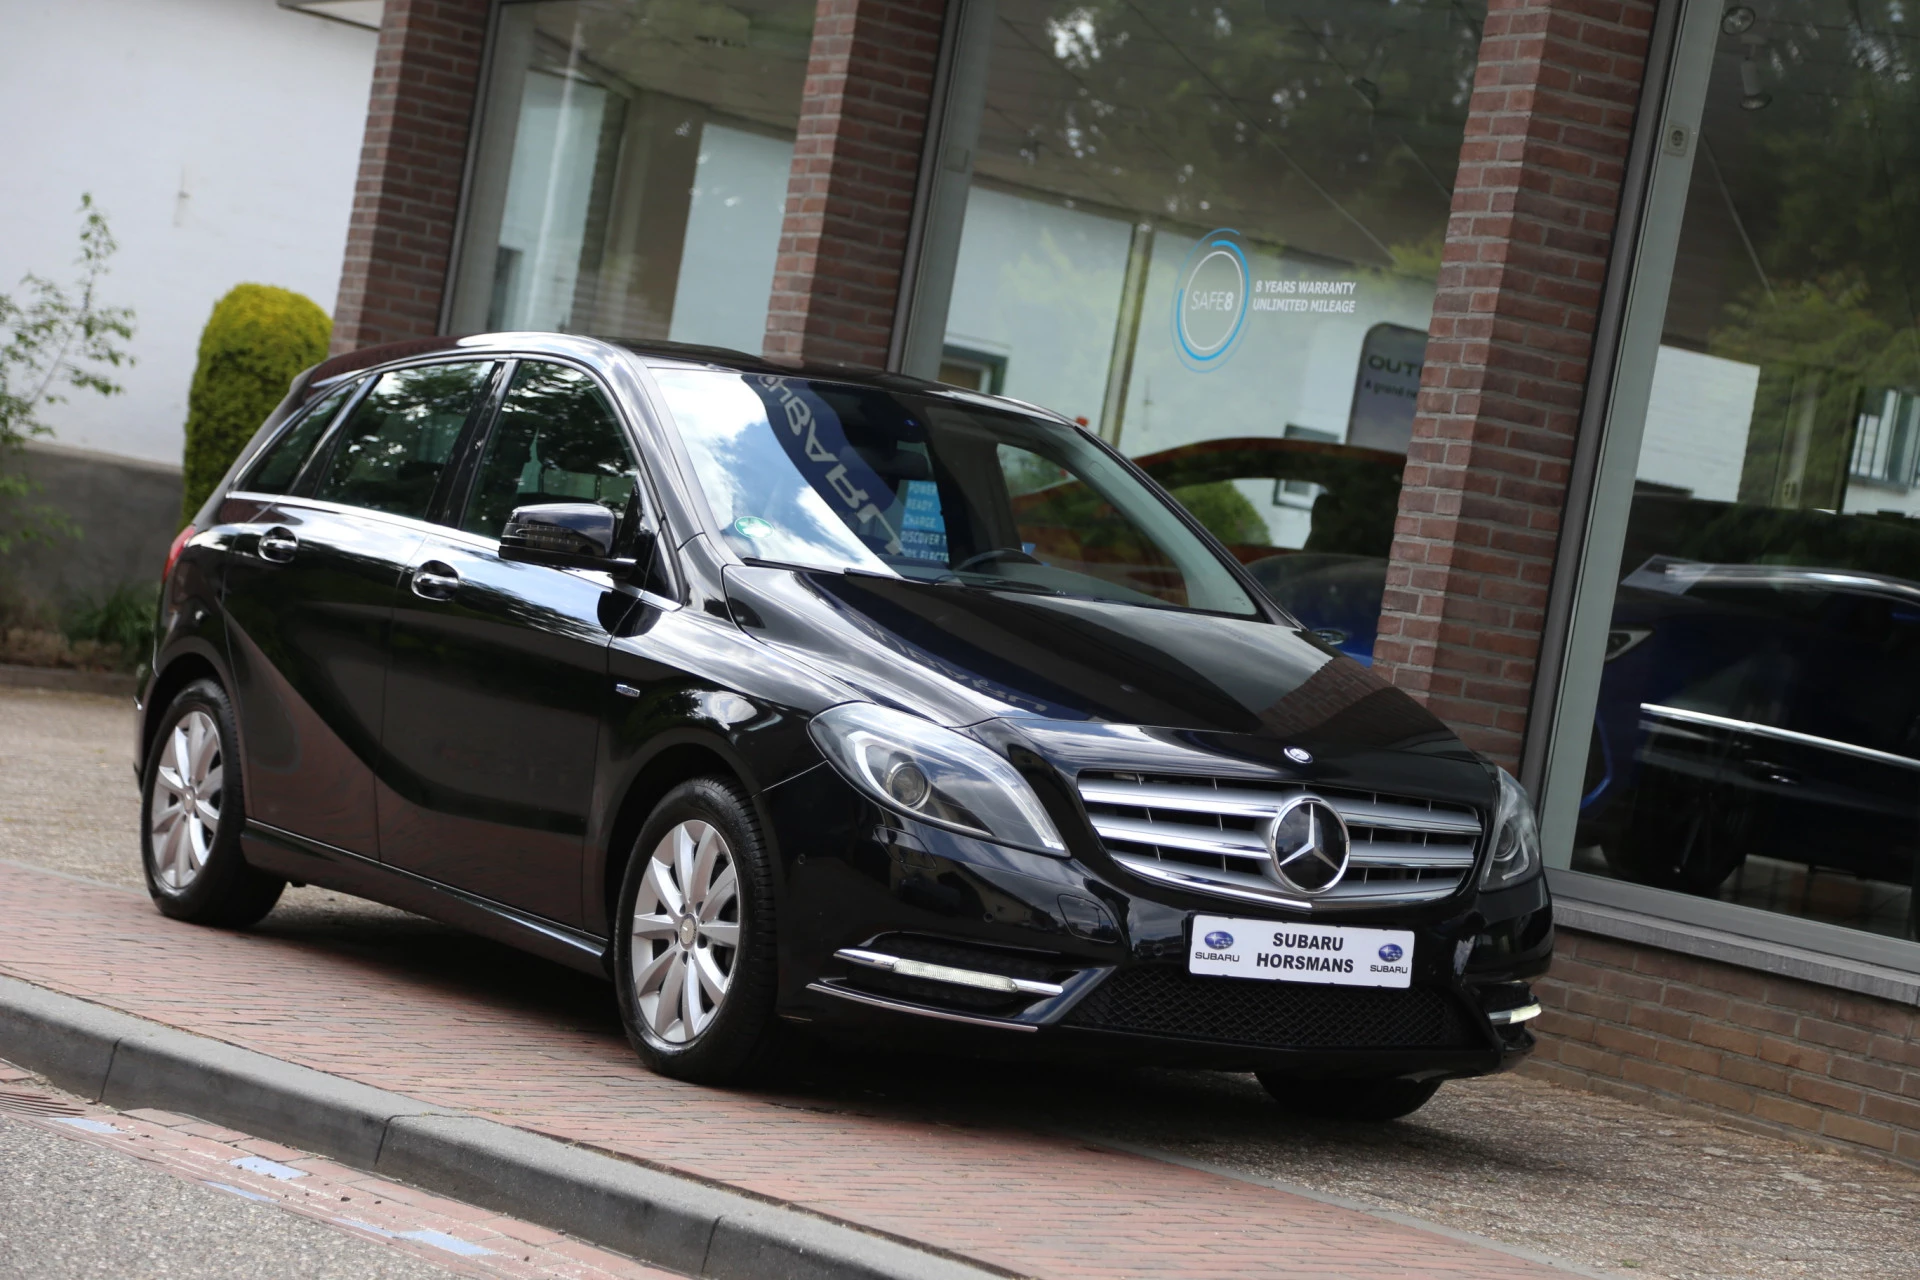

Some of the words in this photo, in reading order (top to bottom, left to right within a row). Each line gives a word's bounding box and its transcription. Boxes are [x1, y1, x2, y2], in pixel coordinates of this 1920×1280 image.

[1255, 280, 1262, 293] 8
[1264, 281, 1297, 294] YEARS
[1299, 281, 1357, 295] WARRANTY
[1191, 290, 1234, 312] SAFE8
[1252, 298, 1308, 312] UNLIMITED
[1310, 299, 1356, 313] MILEAGE
[1272, 932, 1344, 952] SUBARU
[1195, 951, 1240, 963] SUBARU
[1256, 952, 1354, 974] HORSMANS
[1370, 964, 1408, 975] SUBARU
